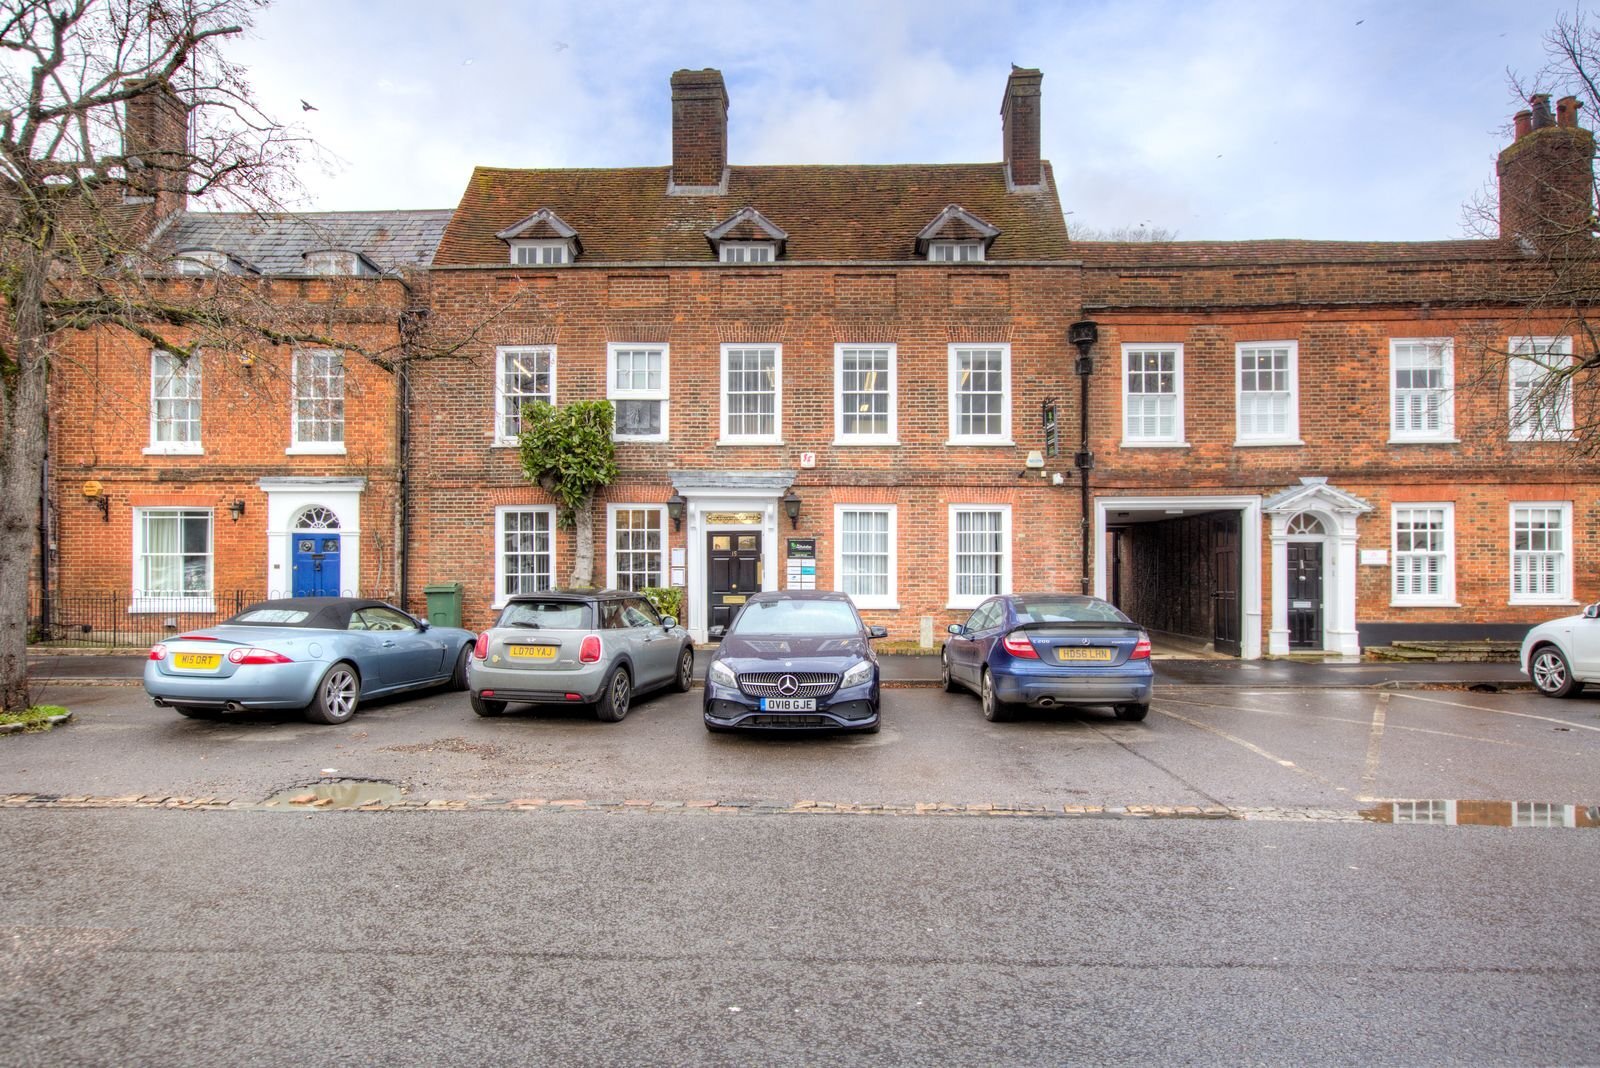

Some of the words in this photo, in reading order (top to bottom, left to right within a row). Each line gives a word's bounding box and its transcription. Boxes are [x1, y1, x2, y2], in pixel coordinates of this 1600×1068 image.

[536, 647, 553, 657] YAJ
[768, 700, 791, 710] OV18
[793, 700, 813, 710] GJE
